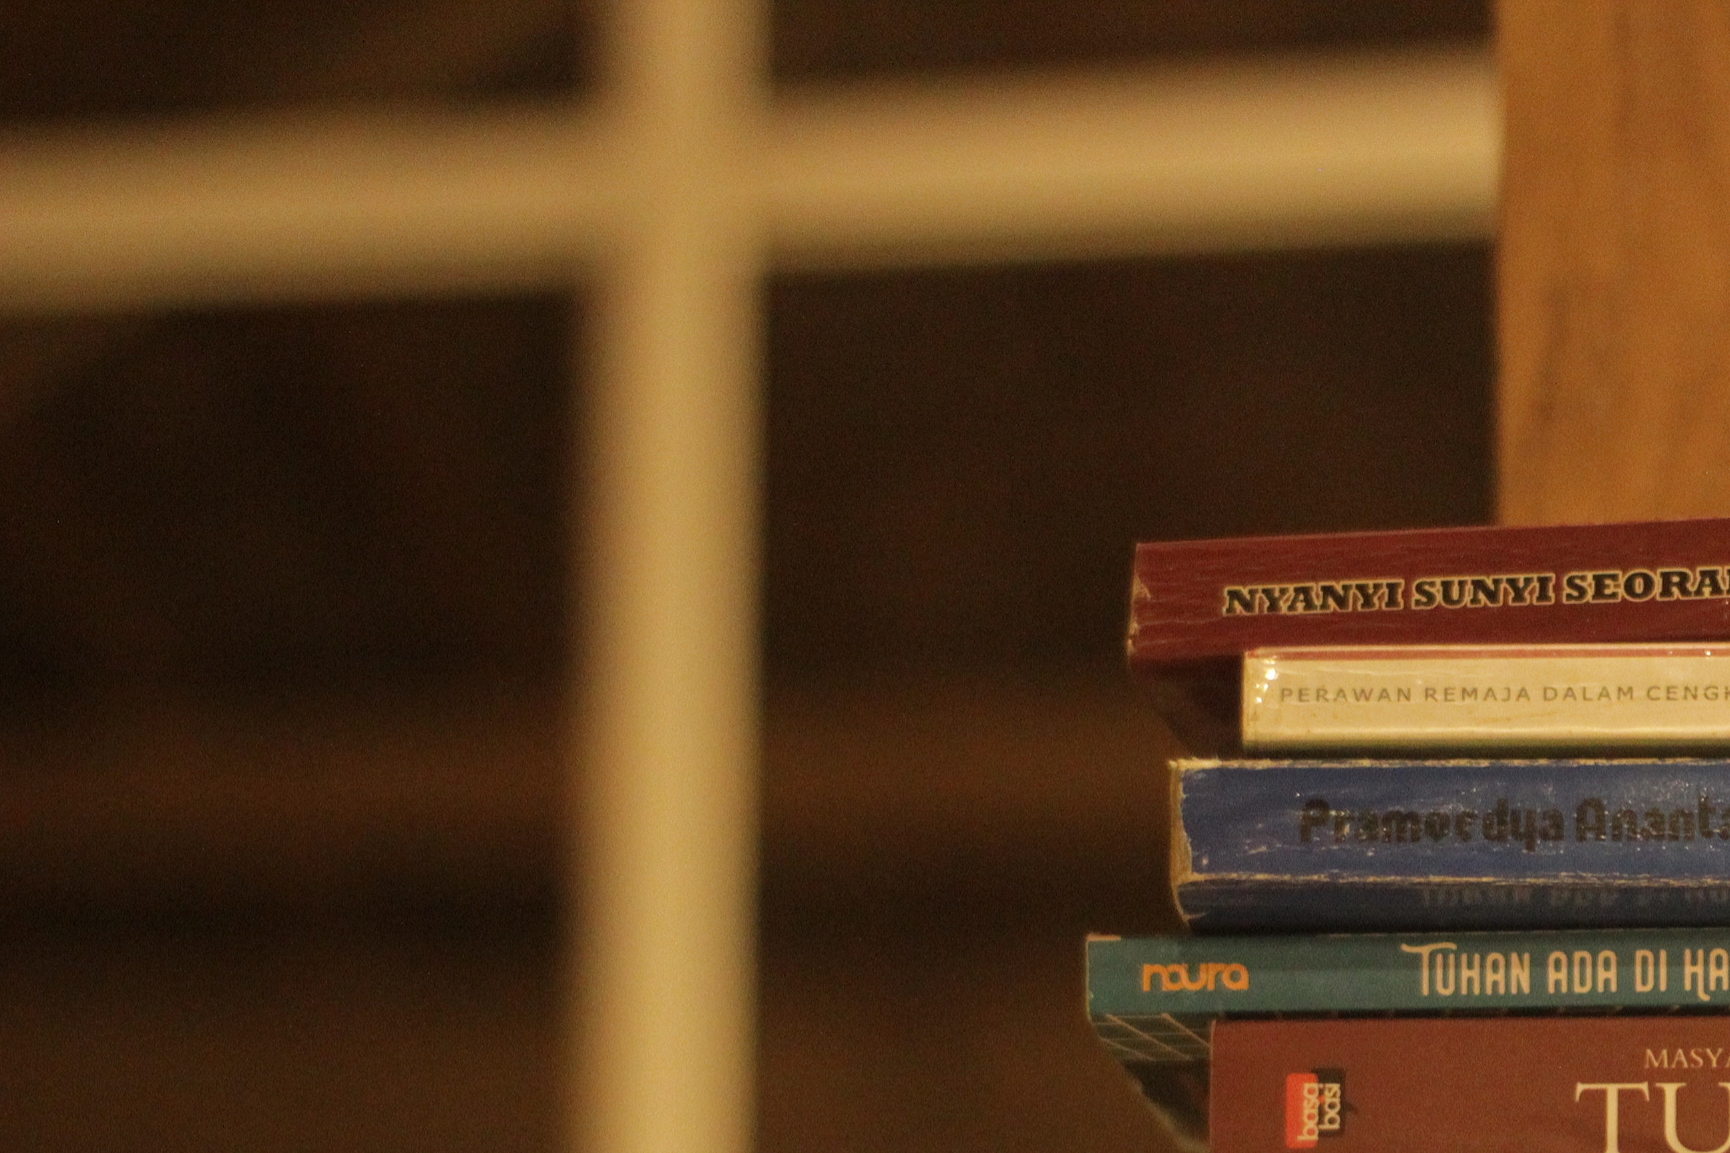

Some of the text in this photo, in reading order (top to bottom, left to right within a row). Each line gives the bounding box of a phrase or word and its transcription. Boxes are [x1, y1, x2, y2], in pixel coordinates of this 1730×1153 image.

[1222, 580, 1404, 616] NYANYI
[1412, 574, 1555, 610] SUNYI
[1280, 686, 1412, 703] PERAWAN
[1425, 686, 1531, 703] REMAJA
[1543, 685, 1636, 702] DALAM
[1300, 798, 1564, 852] Pramoedya
[1142, 962, 1249, 992] noura
[1401, 942, 1531, 997] TUHAN
[1548, 950, 1619, 994] ADA
[1635, 949, 1667, 993] DI
[1297, 1082, 1319, 1140] basa
[1318, 1083, 1341, 1130] basi
